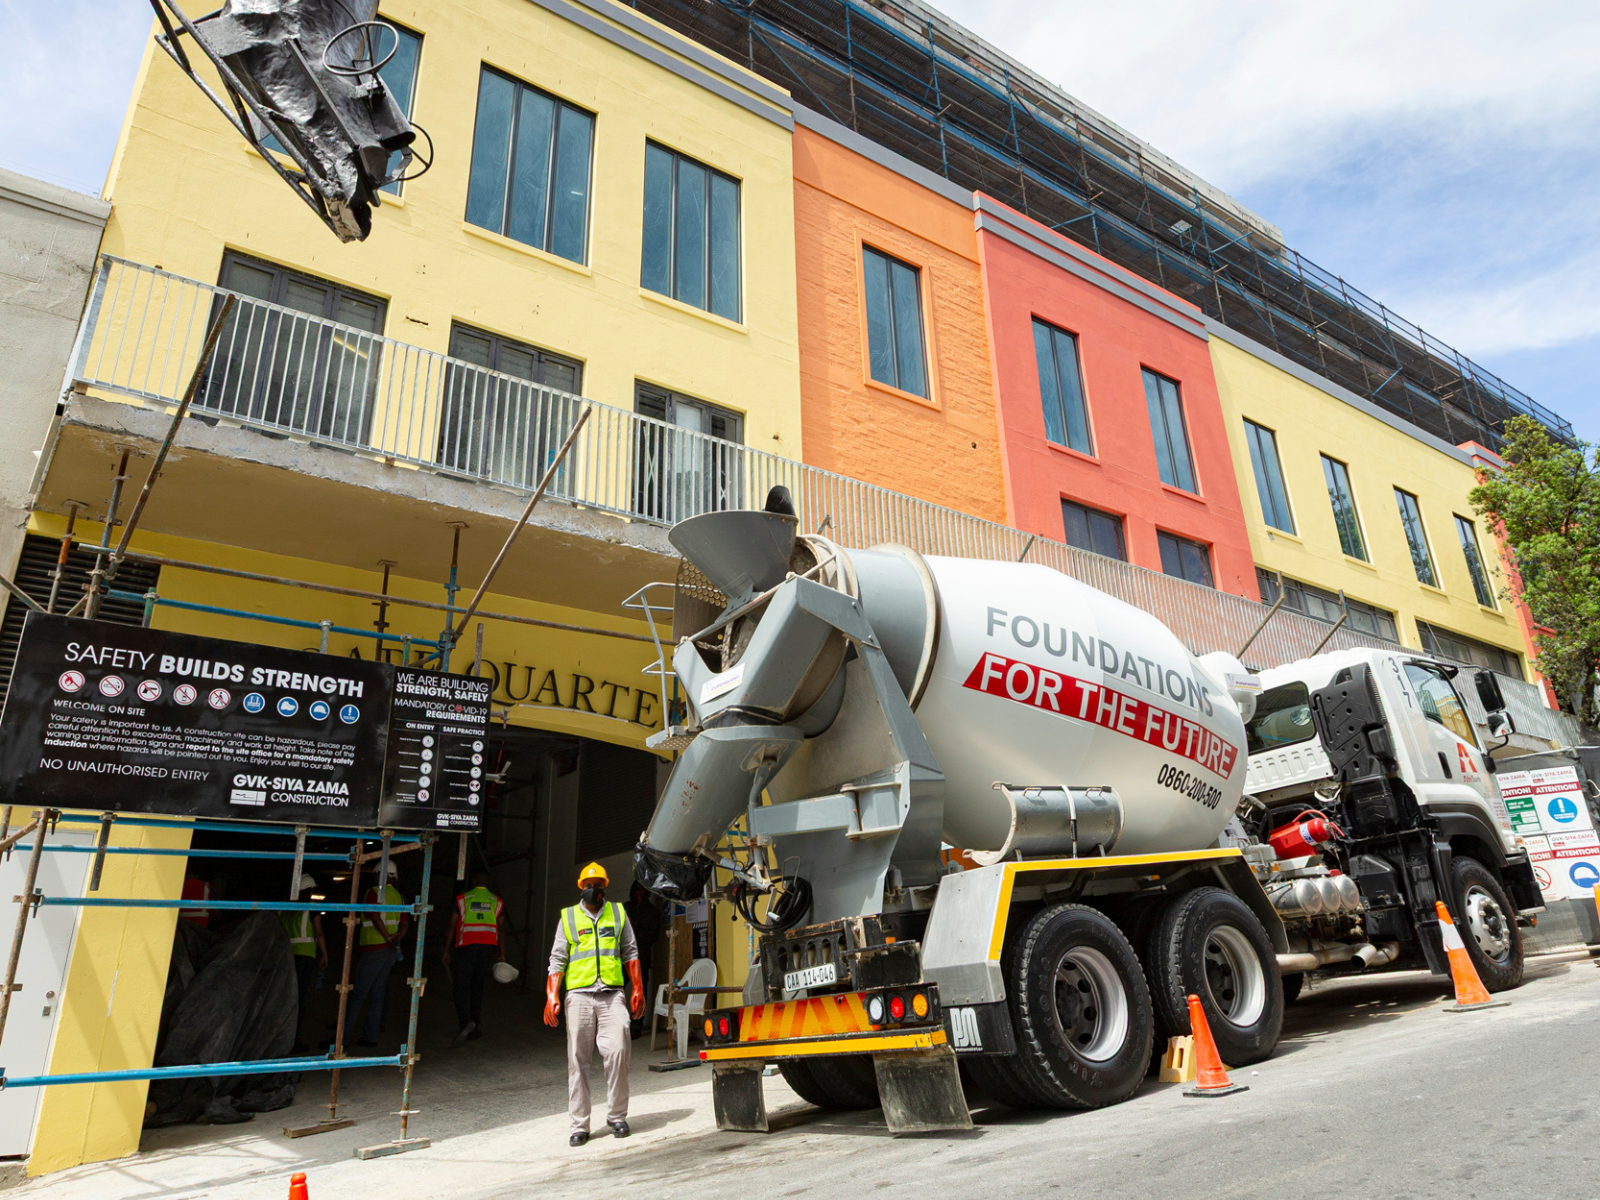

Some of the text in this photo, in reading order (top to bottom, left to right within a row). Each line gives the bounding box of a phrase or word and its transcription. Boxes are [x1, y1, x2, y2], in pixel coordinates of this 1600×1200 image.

[64, 642, 364, 698] SAFETY BUILDS STRENGTH
[986, 606, 1213, 717] FOUNDATIONS
[396, 683, 489, 702] STRENGTH, SAFELY
[397, 672, 489, 693] WE ARE BUILDING
[394, 698, 446, 710] MANDATORY
[465, 659, 687, 731] QUARTE
[54, 699, 145, 716] WELCOME ON SITE
[426, 710, 486, 723] REQUIREMENTS
[980, 654, 1231, 778] FOR THE FUTURE
[48, 723, 79, 731] careful
[81, 725, 119, 734] attention
[184, 735, 225, 746] machinery
[244, 741, 262, 749] work
[300, 746, 316, 754] Take
[317, 748, 333, 756] note
[50, 713, 70, 722] Your
[72, 716, 98, 726] safety
[109, 719, 150, 729] important
[184, 728, 231, 738] construction
[317, 742, 340, 750] please
[342, 743, 356, 751] pay
[457, 728, 485, 736] PRACTICE
[44, 738, 87, 748] induction
[89, 742, 115, 751] where
[117, 745, 149, 754] hazards
[150, 747, 163, 755] will
[176, 751, 207, 759] pointed
[250, 757, 269, 765] Enjoy
[270, 759, 286, 767] your
[46, 731, 80, 740] warning
[82, 733, 100, 741] and
[101, 735, 147, 746] information
[148, 740, 167, 748] signs
[186, 744, 210, 753] report
[292, 753, 331, 763] mandatory
[332, 757, 354, 766] safety
[39, 758, 209, 781] NO UNAUTHORISED ENTRY
[233, 774, 349, 795] GVK-SIYA ZAMA
[1157, 763, 1222, 810] 0860-200-500
[1502, 787, 1531, 796] ENTION!
[1536, 783, 1578, 793] ATTENTION!
[270, 792, 349, 807] CONSTRUCTION
[1556, 847, 1600, 857] ATTENTION!
[787, 974, 800, 989] CAA
